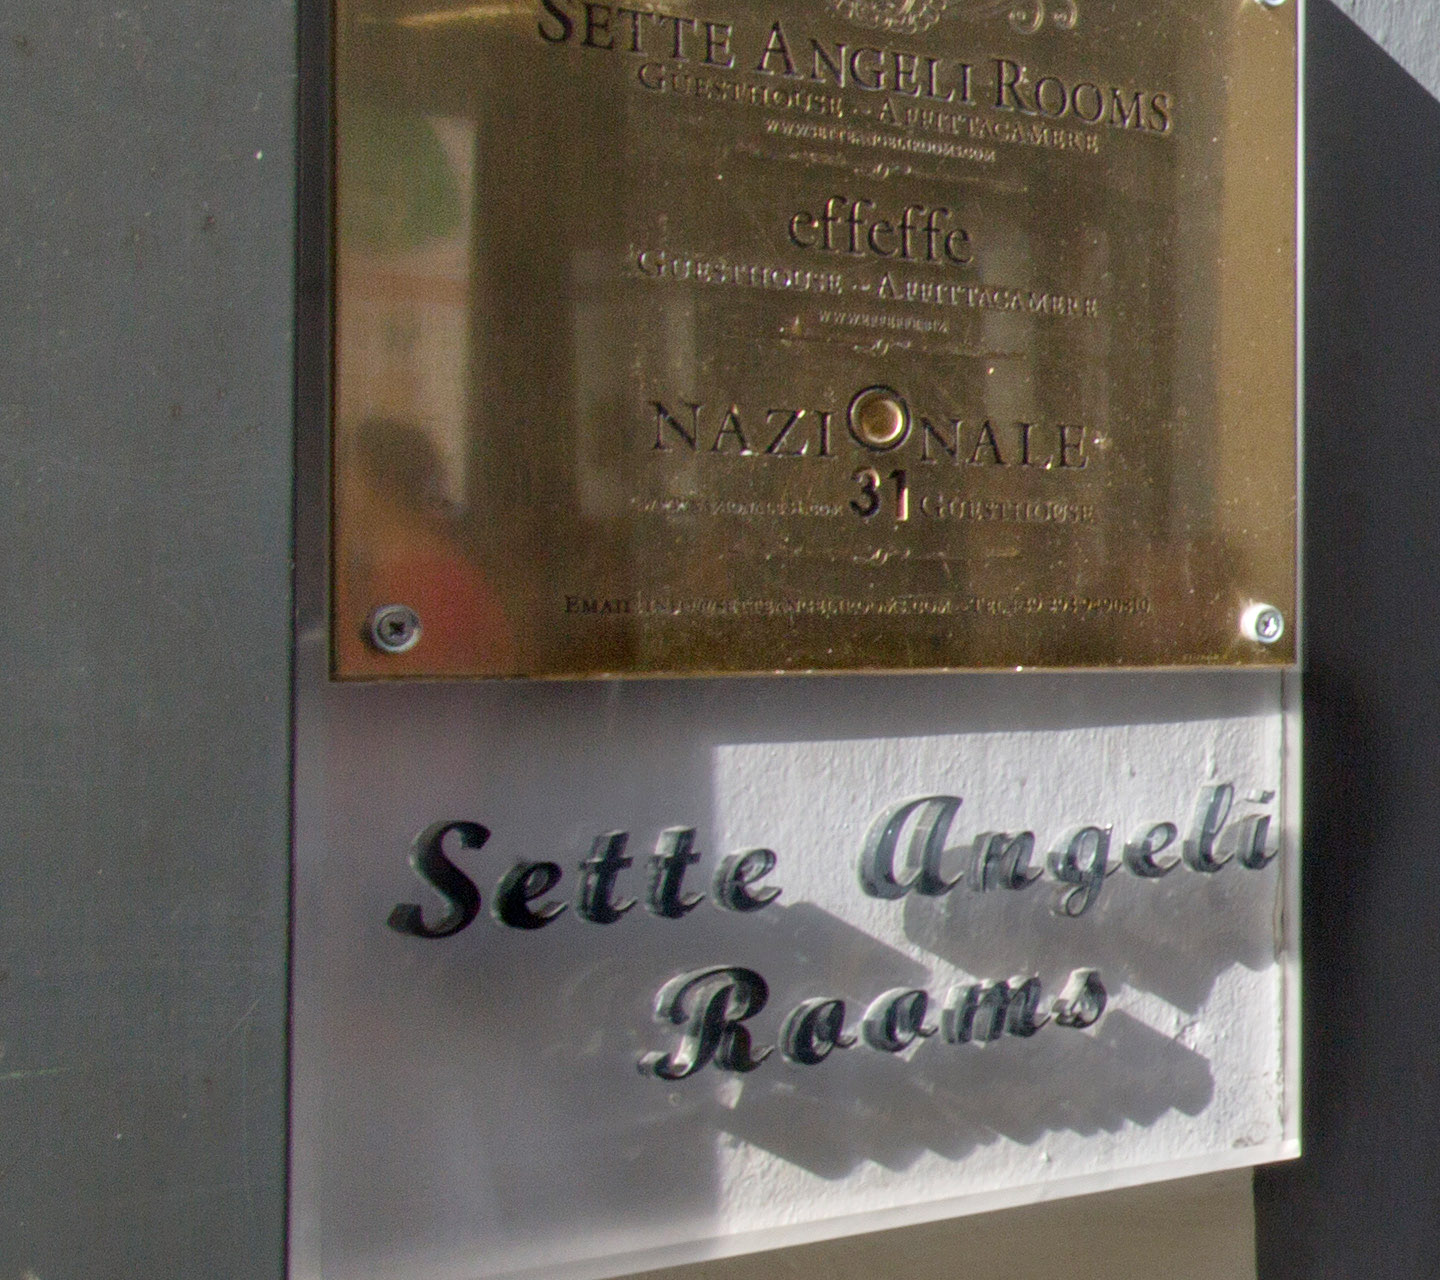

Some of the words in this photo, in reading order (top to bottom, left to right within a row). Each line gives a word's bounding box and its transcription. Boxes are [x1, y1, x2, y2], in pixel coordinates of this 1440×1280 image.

[755, 20, 977, 105] ANGELI
[994, 57, 1173, 135] ROOMS
[787, 194, 972, 266] effeffe
[651, 385, 1089, 470] NAZIONALE
[849, 464, 910, 522] 31
[388, 819, 783, 940] Sette
[857, 779, 1279, 918] Angeli
[636, 964, 1107, 1081] Rooms
